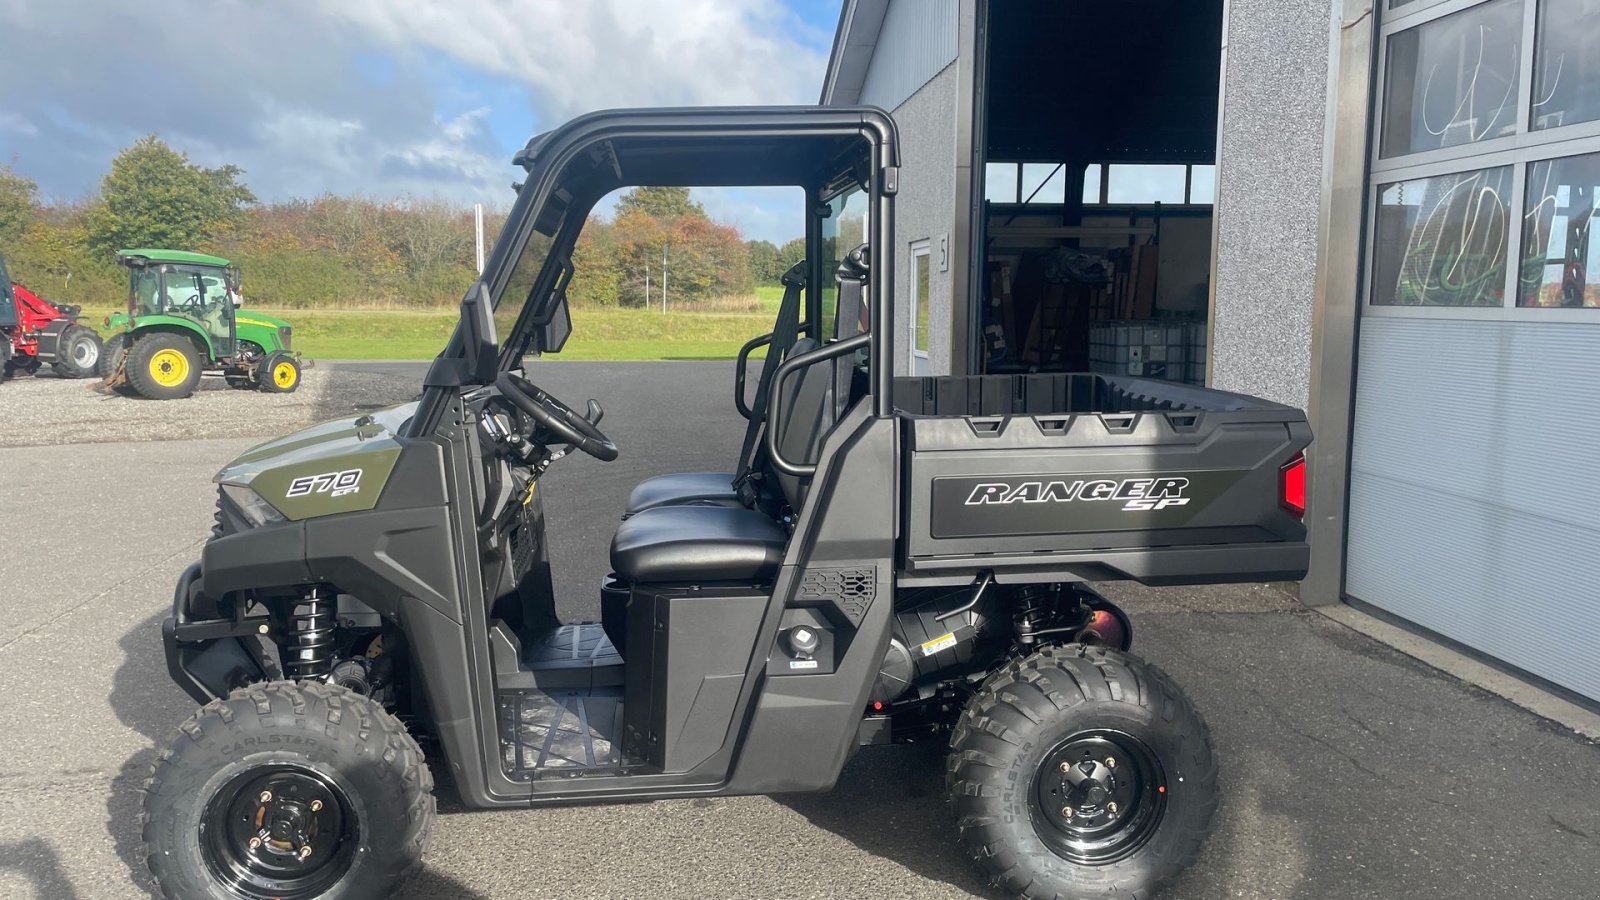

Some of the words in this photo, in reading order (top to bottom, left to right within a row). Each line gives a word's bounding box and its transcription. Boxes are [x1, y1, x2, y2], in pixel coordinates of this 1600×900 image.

[940, 238, 946, 265] 5
[285, 468, 363, 497] 570
[965, 477, 1189, 505] RANGER
[1121, 498, 1190, 511] SP
[221, 734, 317, 755] CARLSTAR
[1003, 741, 1032, 824] CARLSTAR
